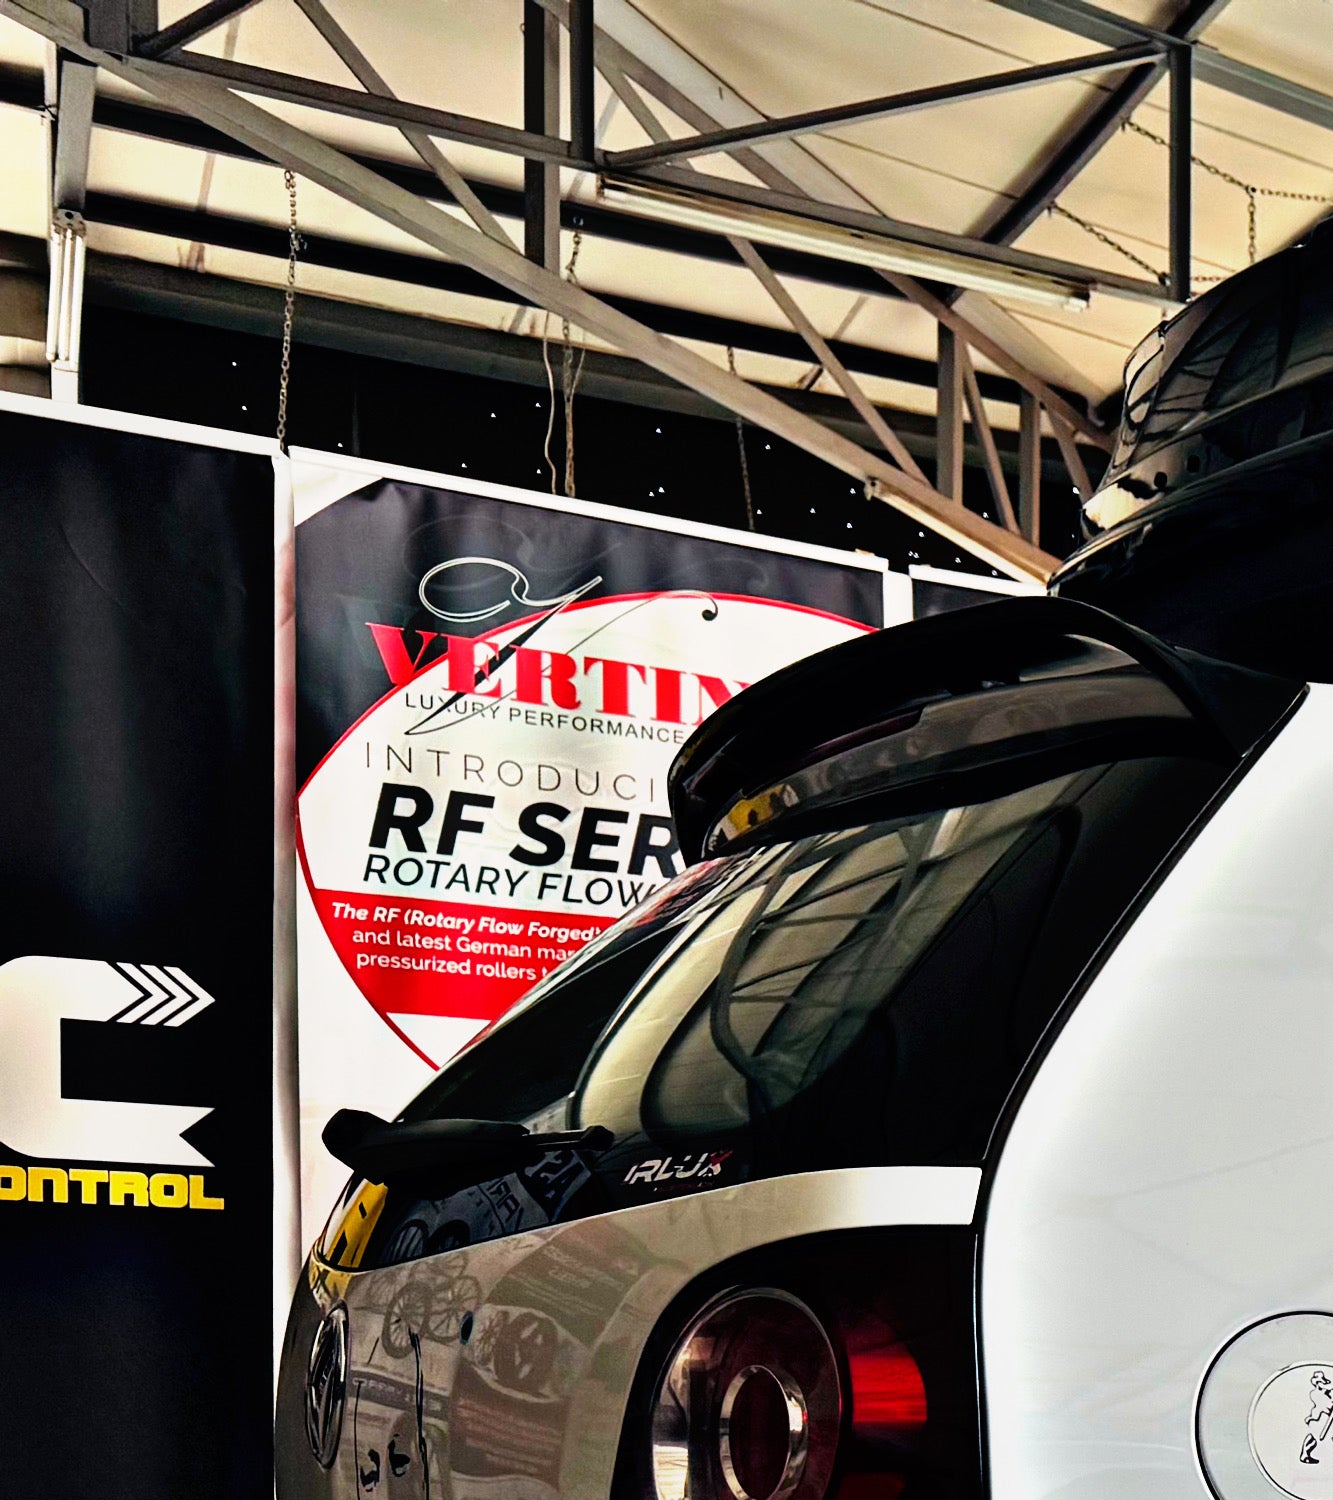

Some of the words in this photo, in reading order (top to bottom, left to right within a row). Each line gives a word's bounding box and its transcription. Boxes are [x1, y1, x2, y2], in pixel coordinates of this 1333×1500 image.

[405, 691, 500, 722] LUXURY
[509, 707, 684, 745] PERFORMANCE
[366, 741, 654, 802] INTRODUCI
[368, 782, 496, 856] RF
[508, 801, 682, 879] SER
[363, 853, 530, 898] ROTARY
[332, 902, 369, 921] The
[373, 906, 401, 923] RF
[404, 908, 475, 934] (Rotary
[479, 918, 524, 936] Flow
[352, 929, 390, 945] and
[397, 930, 451, 950] latest
[456, 937, 532, 958] German
[356, 953, 471, 974] pressurized
[476, 963, 537, 981] rollers
